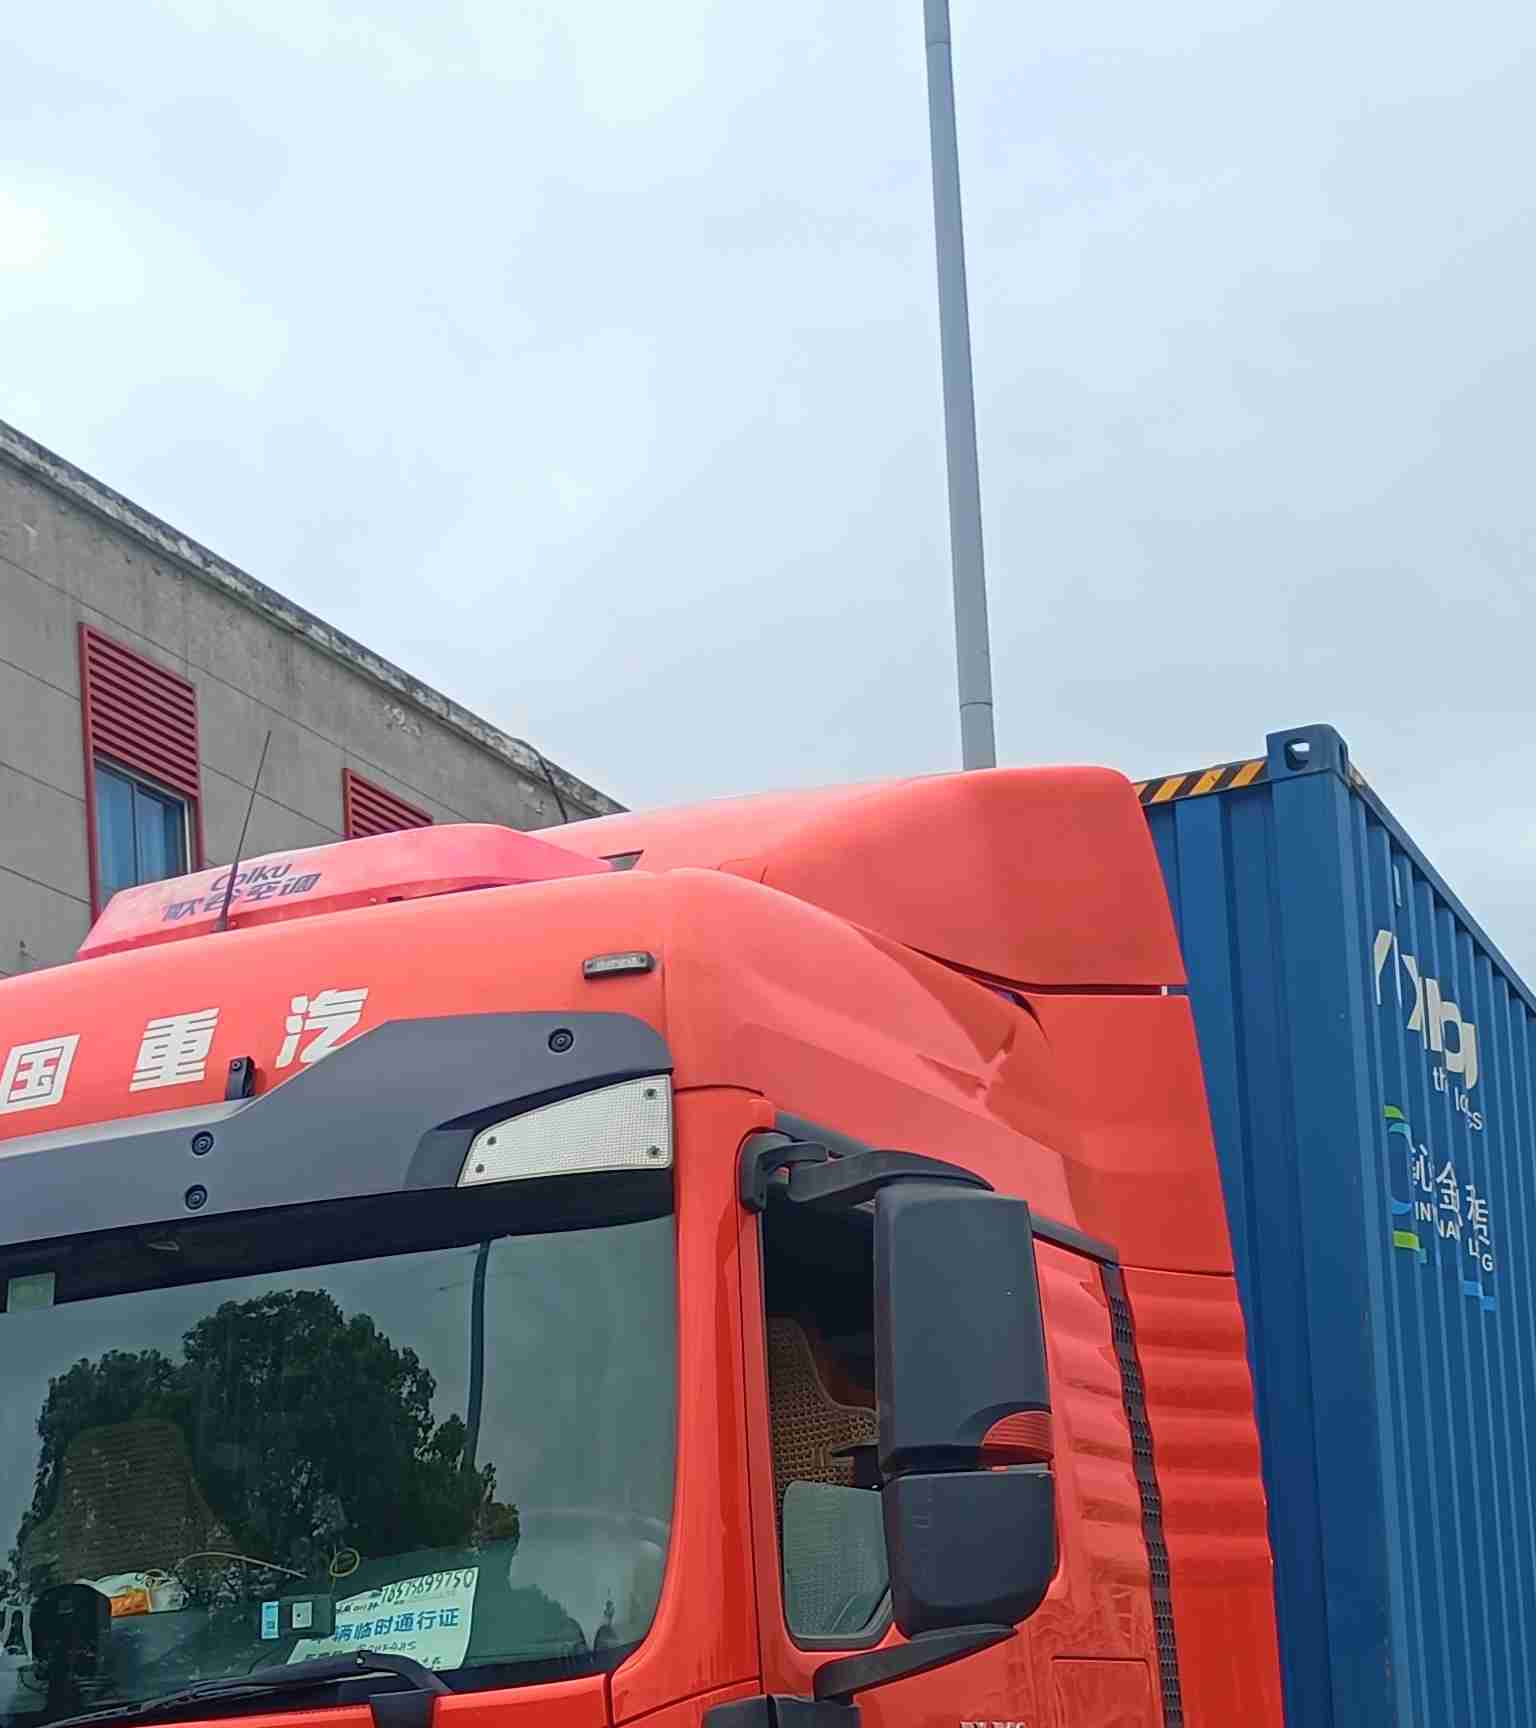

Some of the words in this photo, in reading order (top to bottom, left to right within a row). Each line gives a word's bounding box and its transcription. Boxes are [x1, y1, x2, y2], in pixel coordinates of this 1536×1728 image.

[333, 1607, 460, 1642] 辆临时通行证
